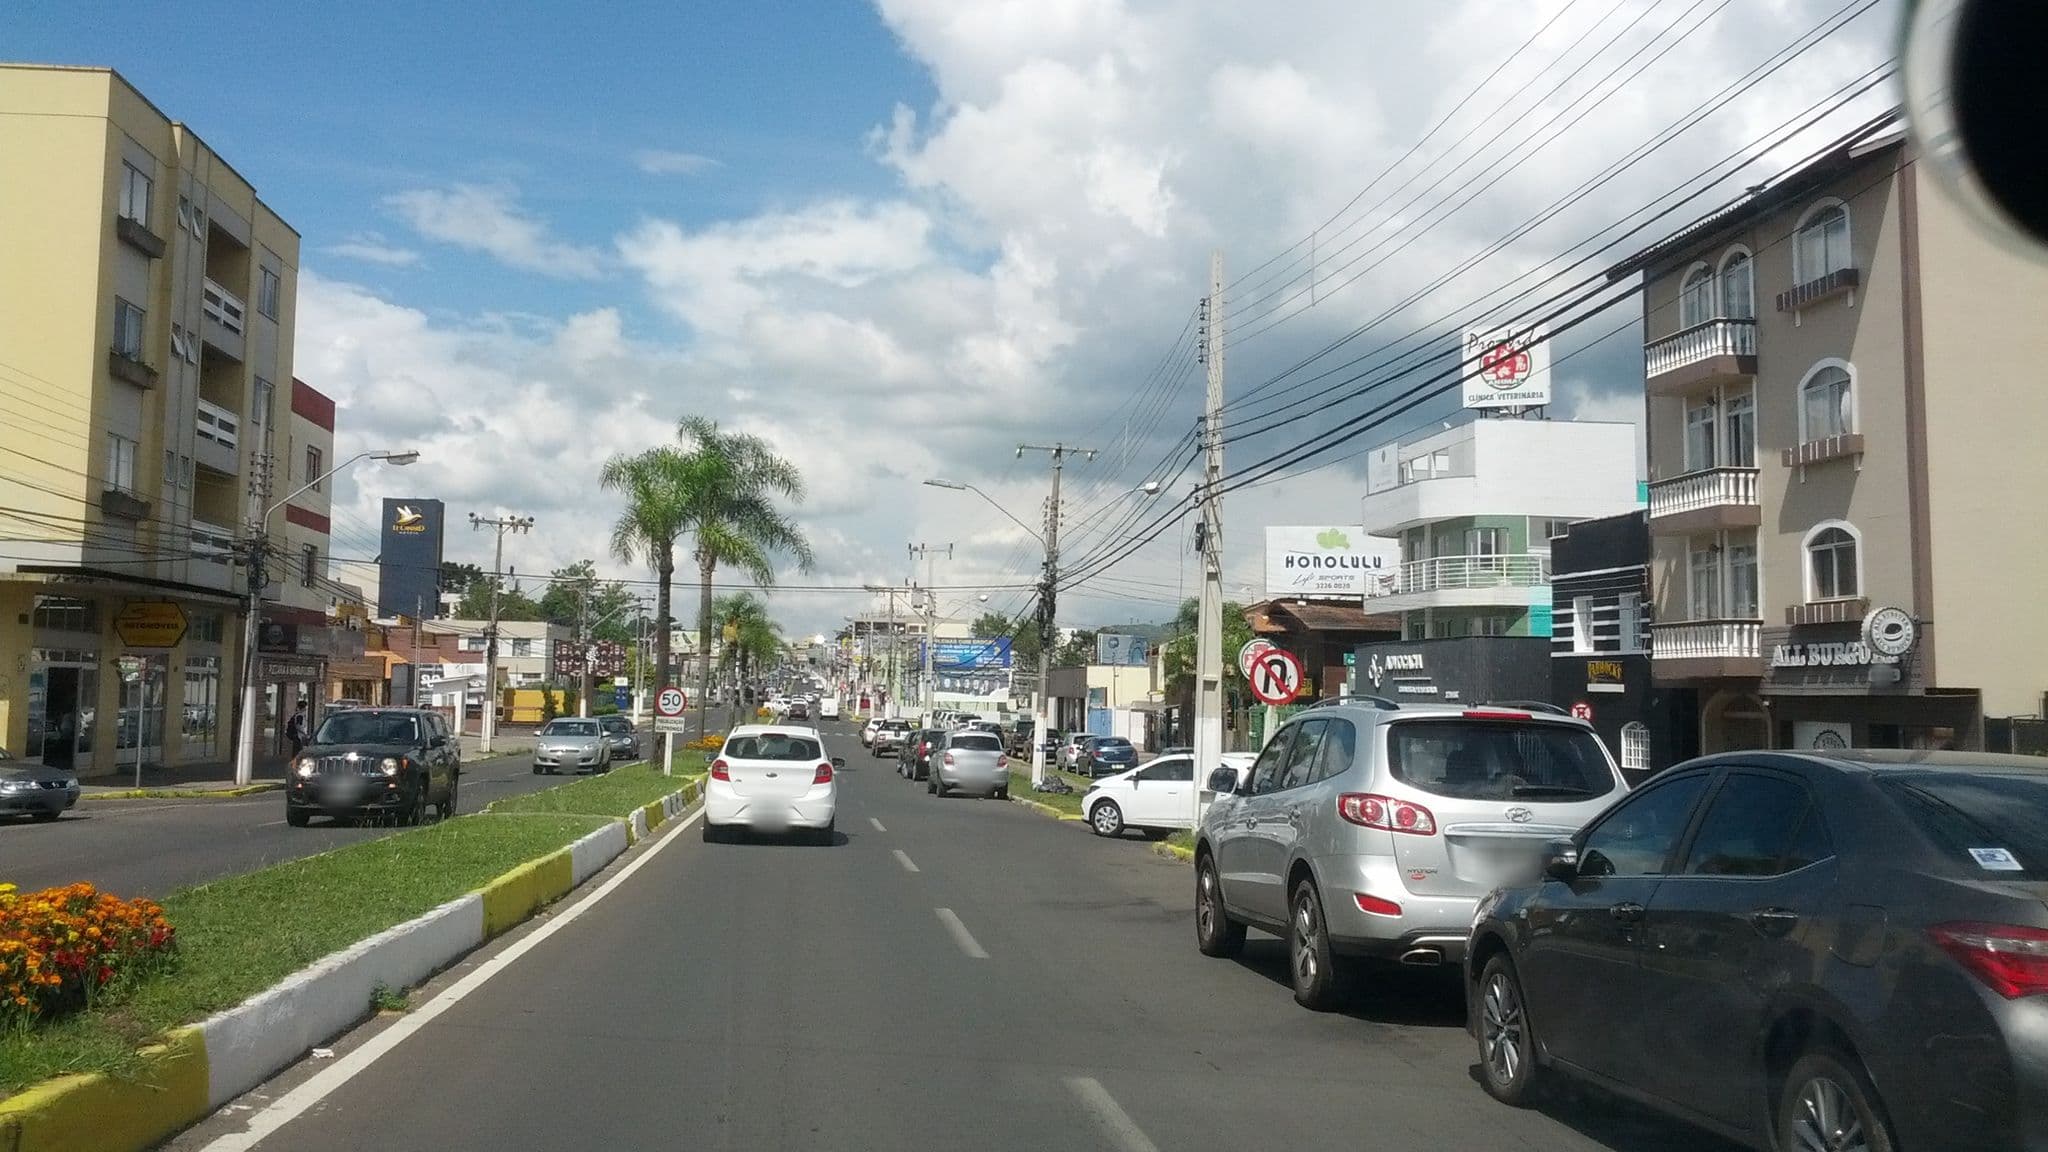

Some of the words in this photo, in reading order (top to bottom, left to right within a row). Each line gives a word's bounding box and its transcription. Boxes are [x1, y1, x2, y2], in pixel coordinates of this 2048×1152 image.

[1285, 555, 1382, 569] HONOLULU
[1771, 644, 1806, 666] ALL
[1807, 641, 1899, 665] BURGU
[662, 694, 681, 706] 50
